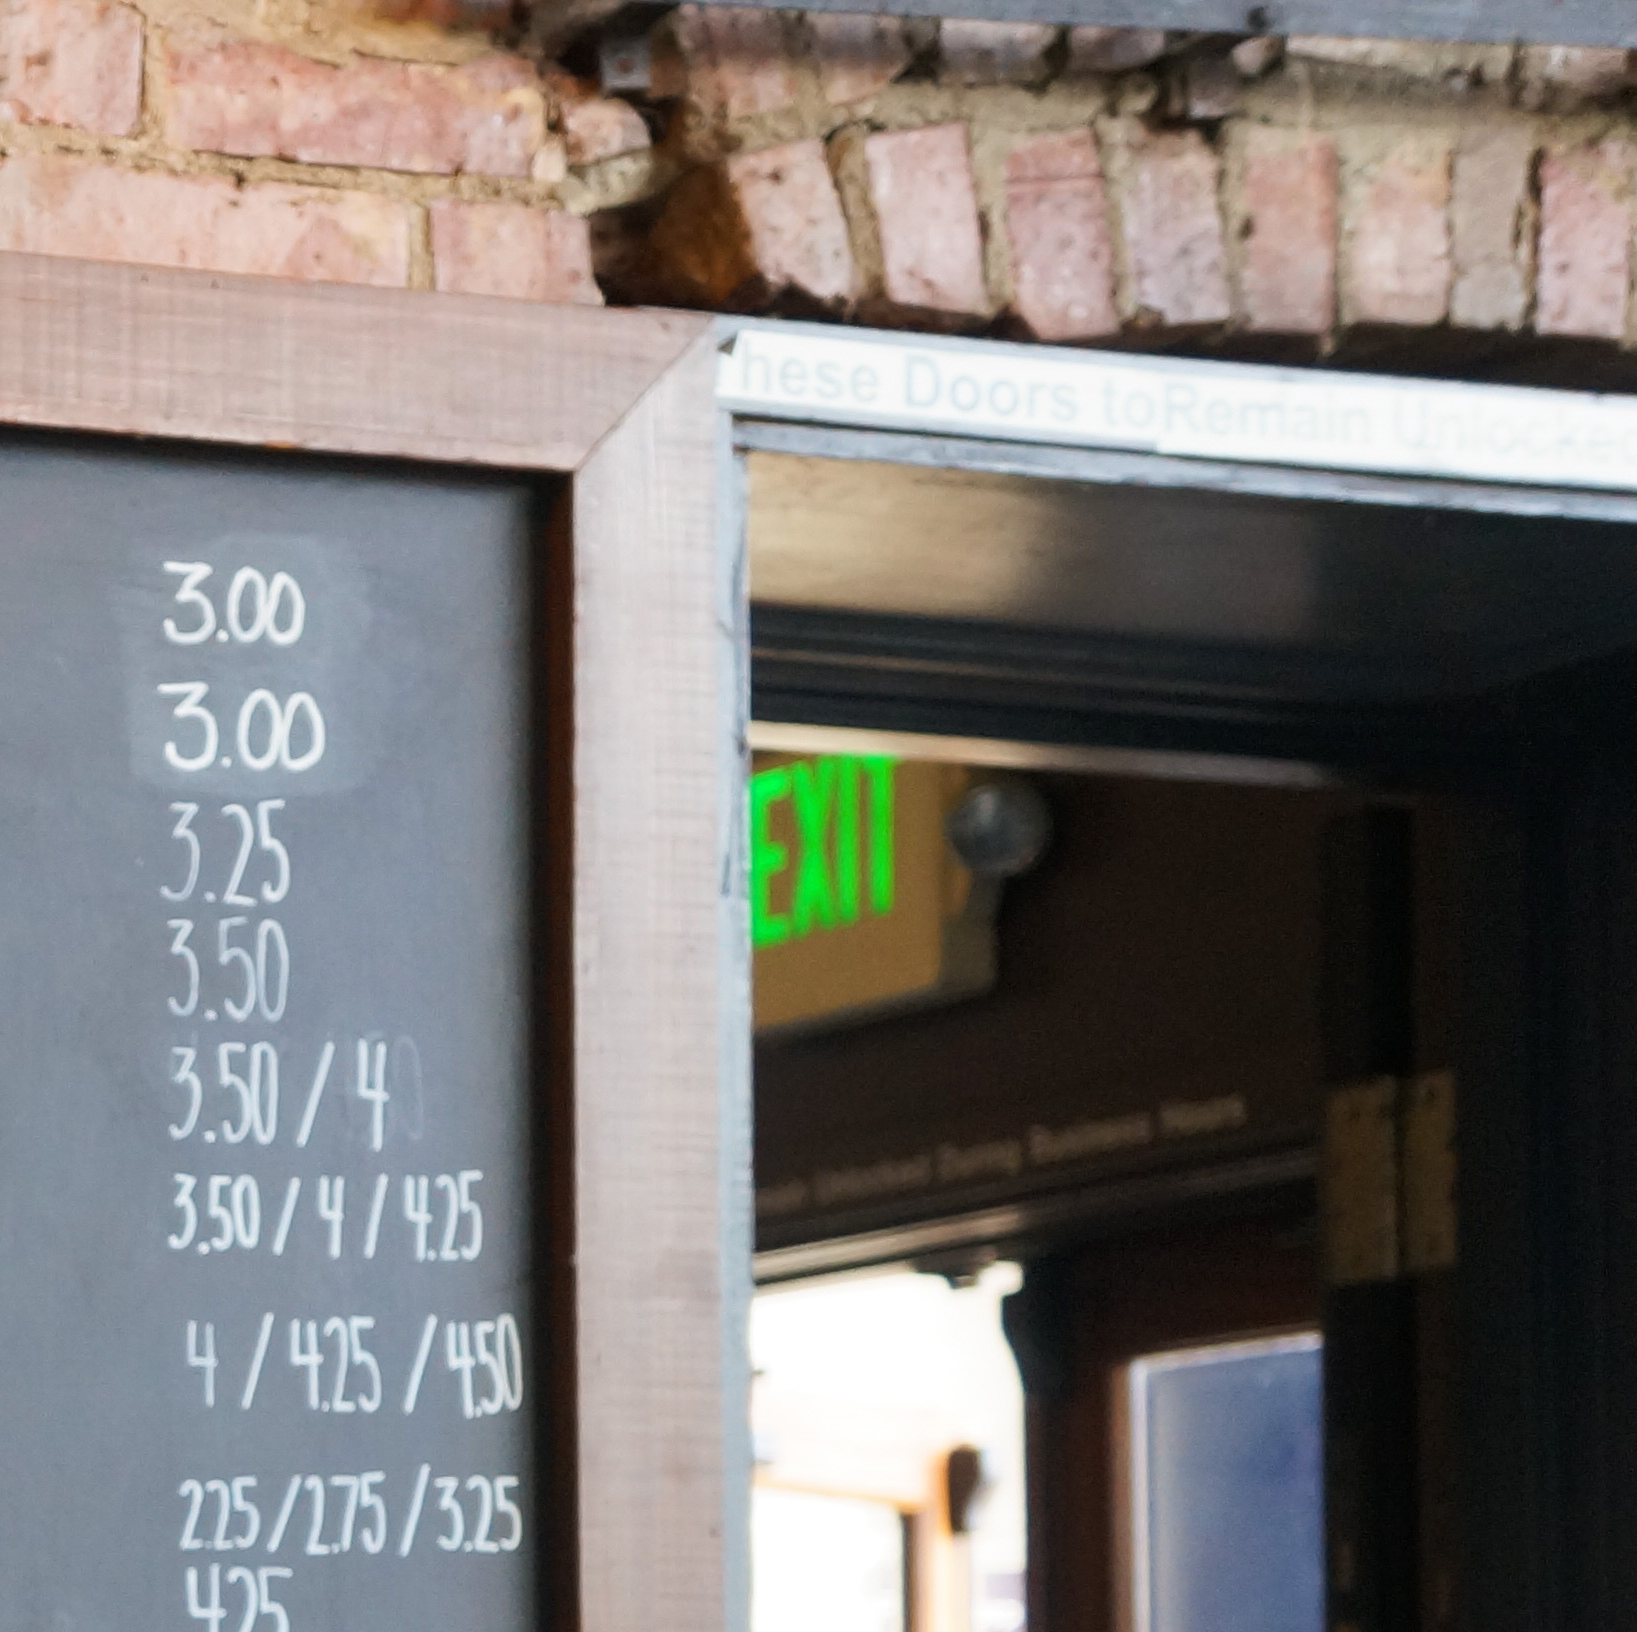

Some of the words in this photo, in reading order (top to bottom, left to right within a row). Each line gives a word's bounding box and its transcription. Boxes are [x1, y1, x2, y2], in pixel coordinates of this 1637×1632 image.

[742, 338, 880, 403] hese
[905, 353, 1079, 424] Doors
[163, 561, 306, 646] 3.00
[156, 681, 325, 772] 3.00
[159, 797, 291, 907] 3.25
[750, 752, 901, 950] EXIT
[166, 916, 290, 1023] 3.50
[168, 1040, 278, 1145] 3.50
[356, 1037, 389, 1152] 4
[167, 1172, 261, 1256] 3.50
[404, 1169, 483, 1262] 4.25
[289, 1315, 382, 1413] 4.25
[445, 1312, 523, 1419] 4.50
